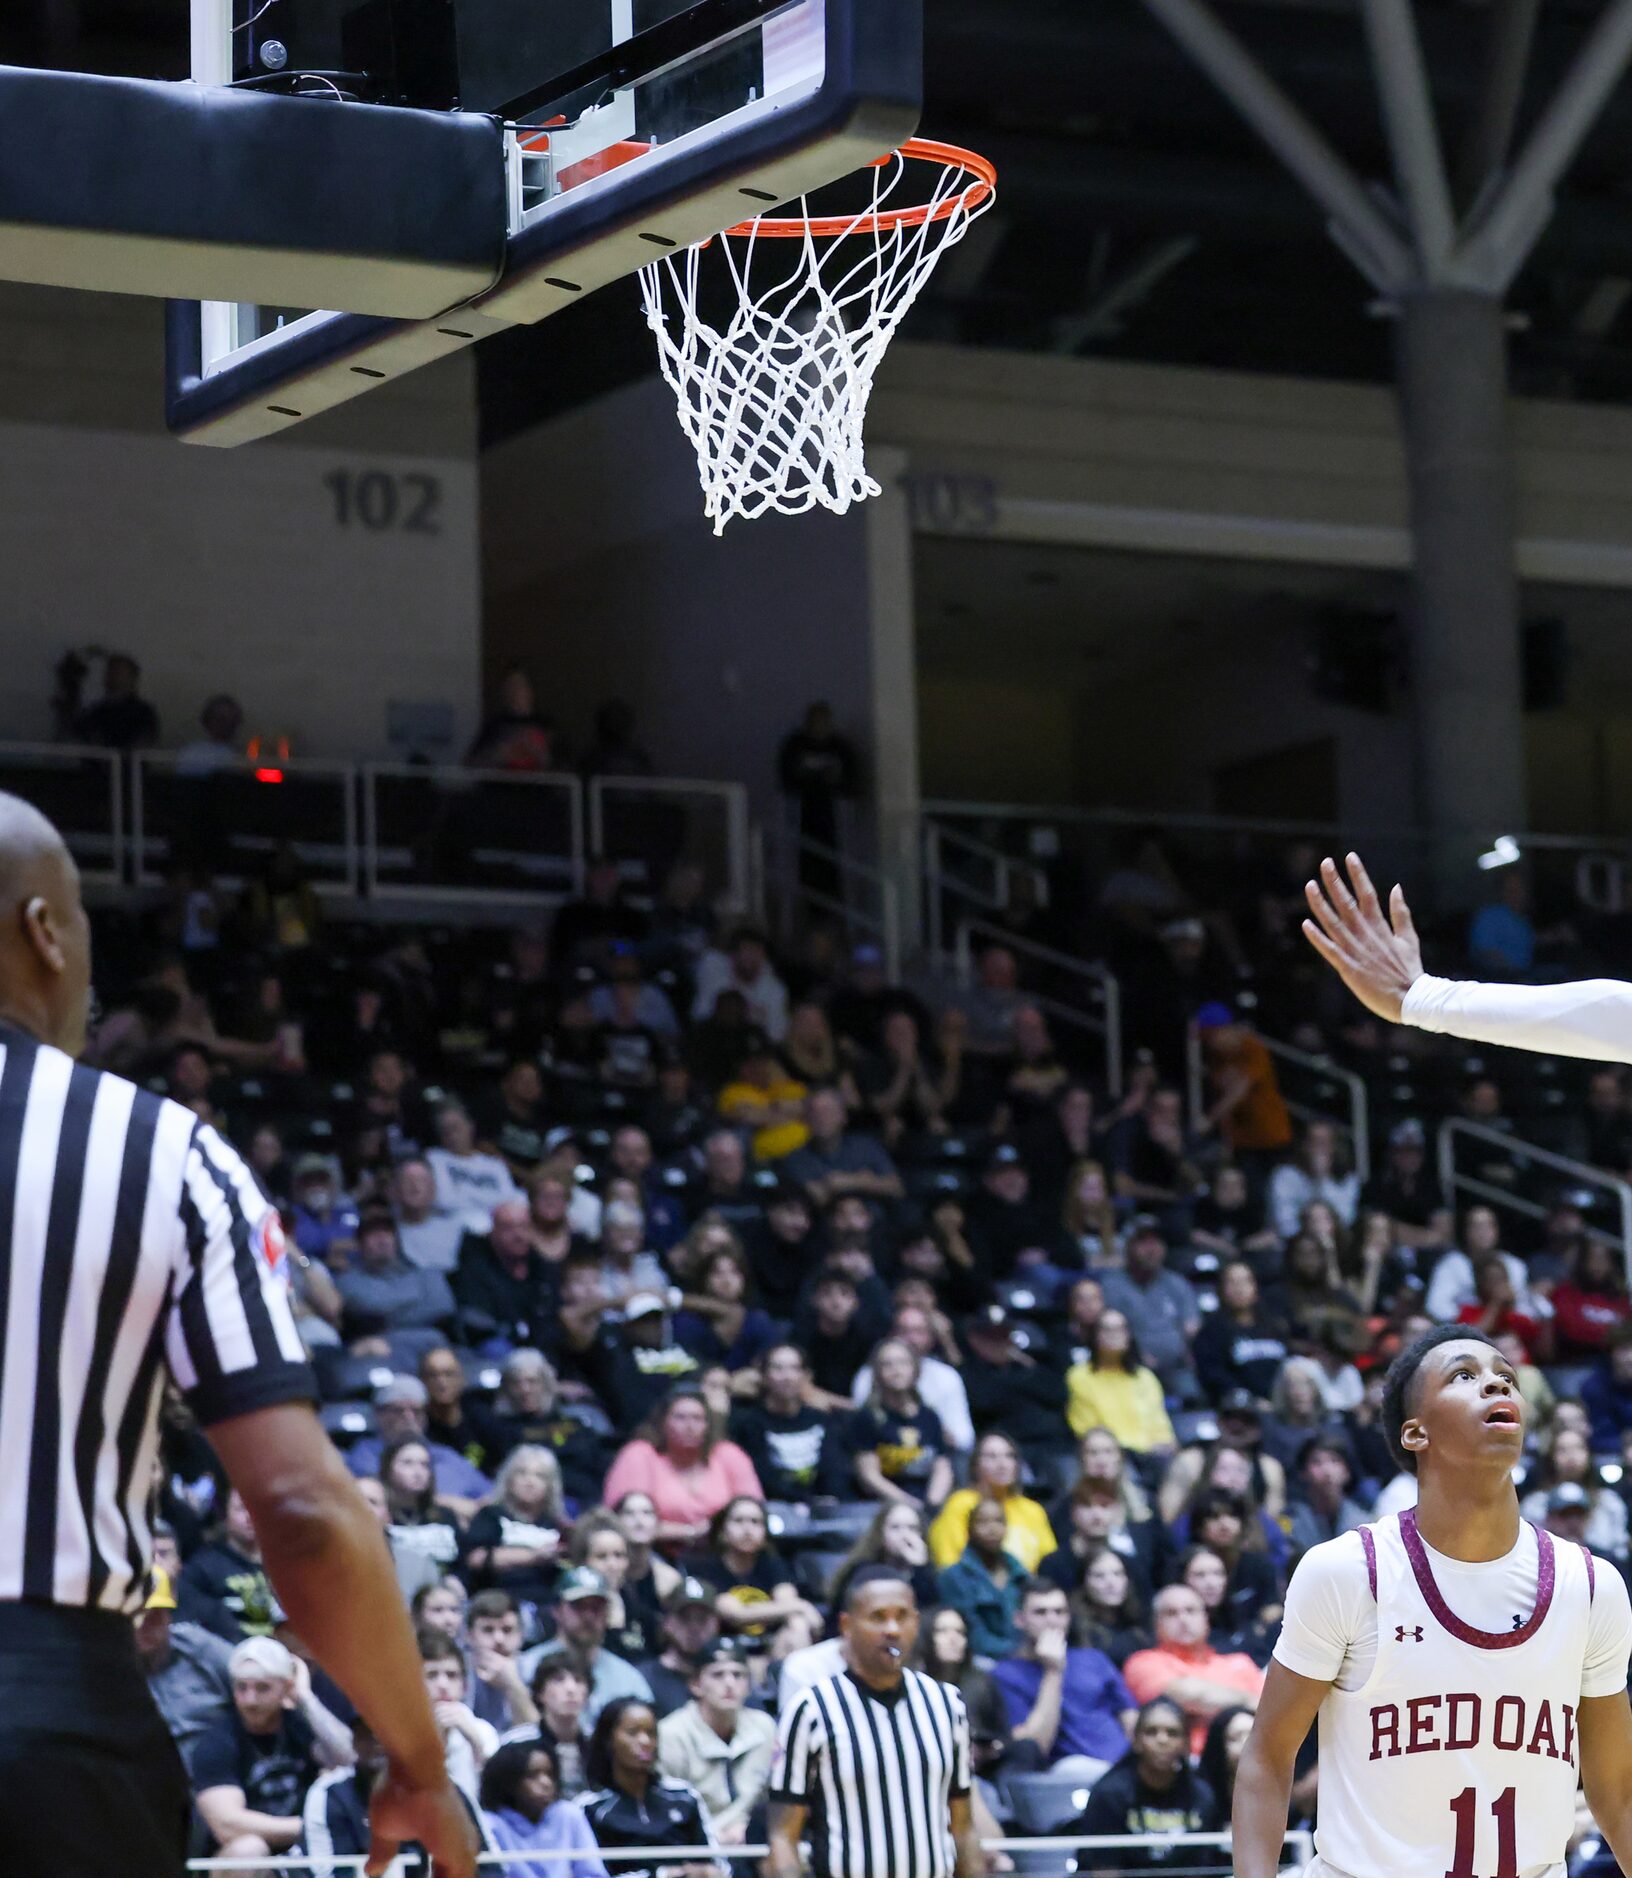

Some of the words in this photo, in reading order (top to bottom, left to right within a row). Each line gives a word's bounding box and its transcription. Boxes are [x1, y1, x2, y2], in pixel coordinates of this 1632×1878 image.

[322, 467, 443, 534] 102
[1369, 1693, 1481, 1761] RED
[1445, 1786, 1521, 1878] 11
